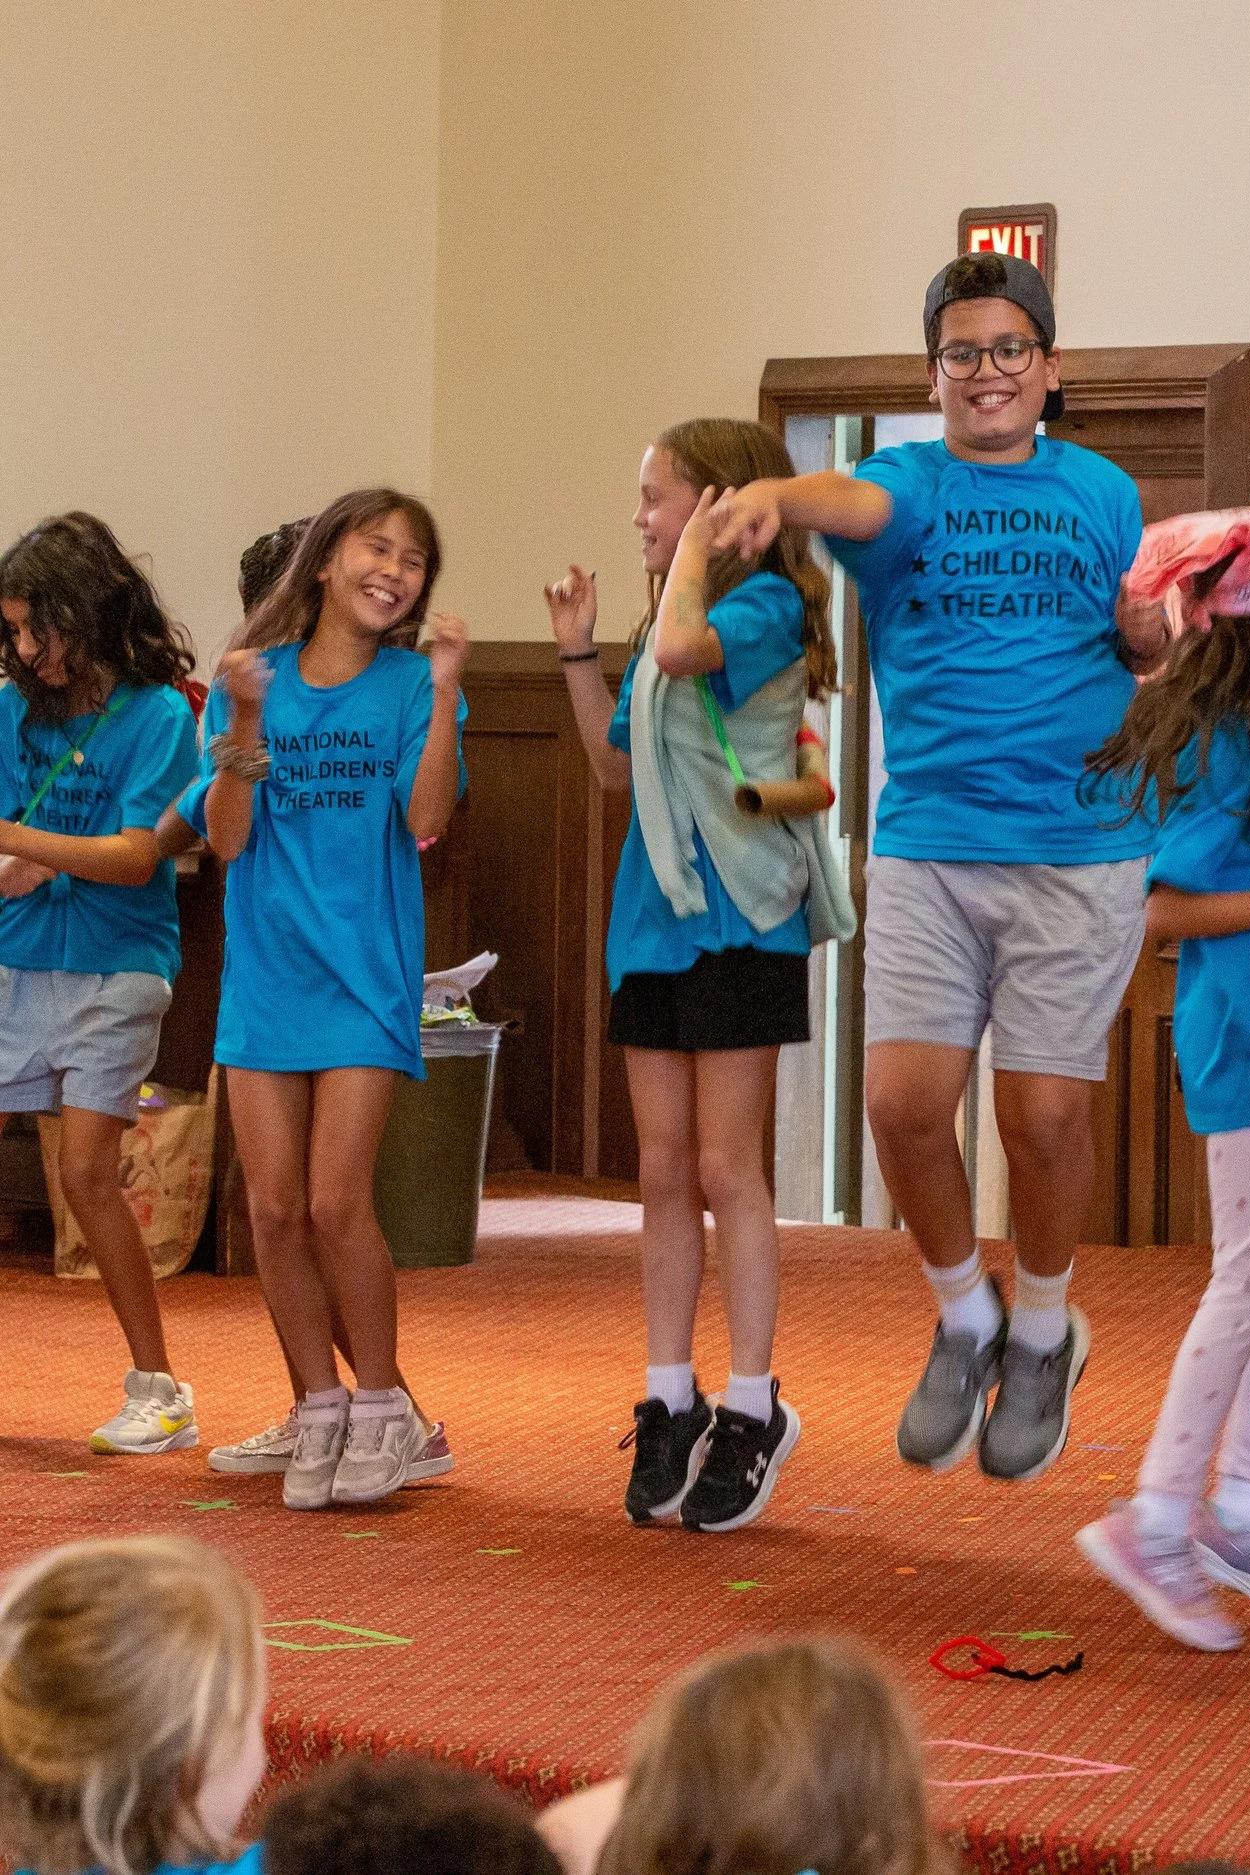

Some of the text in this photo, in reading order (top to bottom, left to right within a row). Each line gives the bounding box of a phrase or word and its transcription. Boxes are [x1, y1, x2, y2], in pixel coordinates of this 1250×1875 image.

[945, 508, 1085, 542] NATIONAL
[940, 551, 1103, 587] CHILDRENS
[937, 592, 1073, 617] THEATRE
[274, 731, 376, 753] NATIONAL
[275, 760, 396, 783] CHILDREN'S
[275, 791, 366, 810] THEATRE
